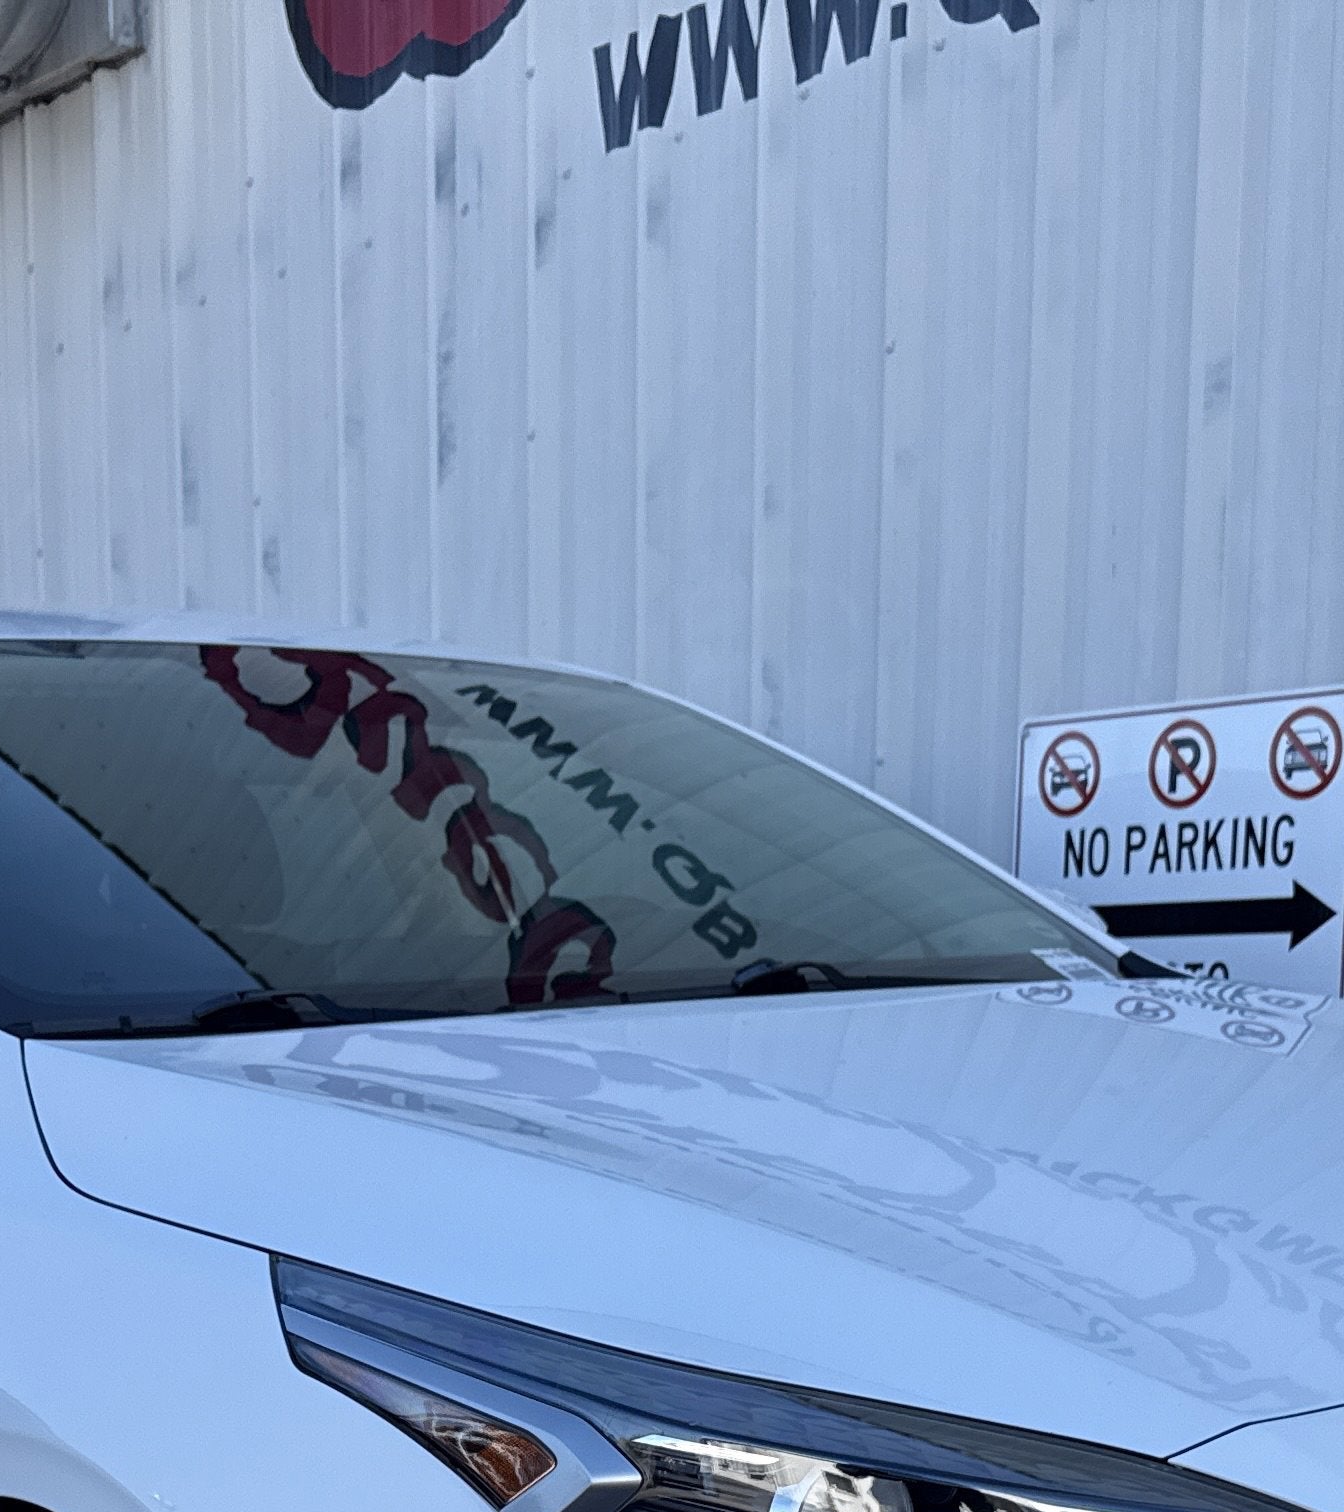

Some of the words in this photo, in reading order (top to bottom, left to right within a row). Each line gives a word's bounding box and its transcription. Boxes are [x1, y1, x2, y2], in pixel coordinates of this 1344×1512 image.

[593, 0, 1041, 154] WWW.
[1063, 827, 1109, 878] NO
[1123, 814, 1296, 875] PARKING
